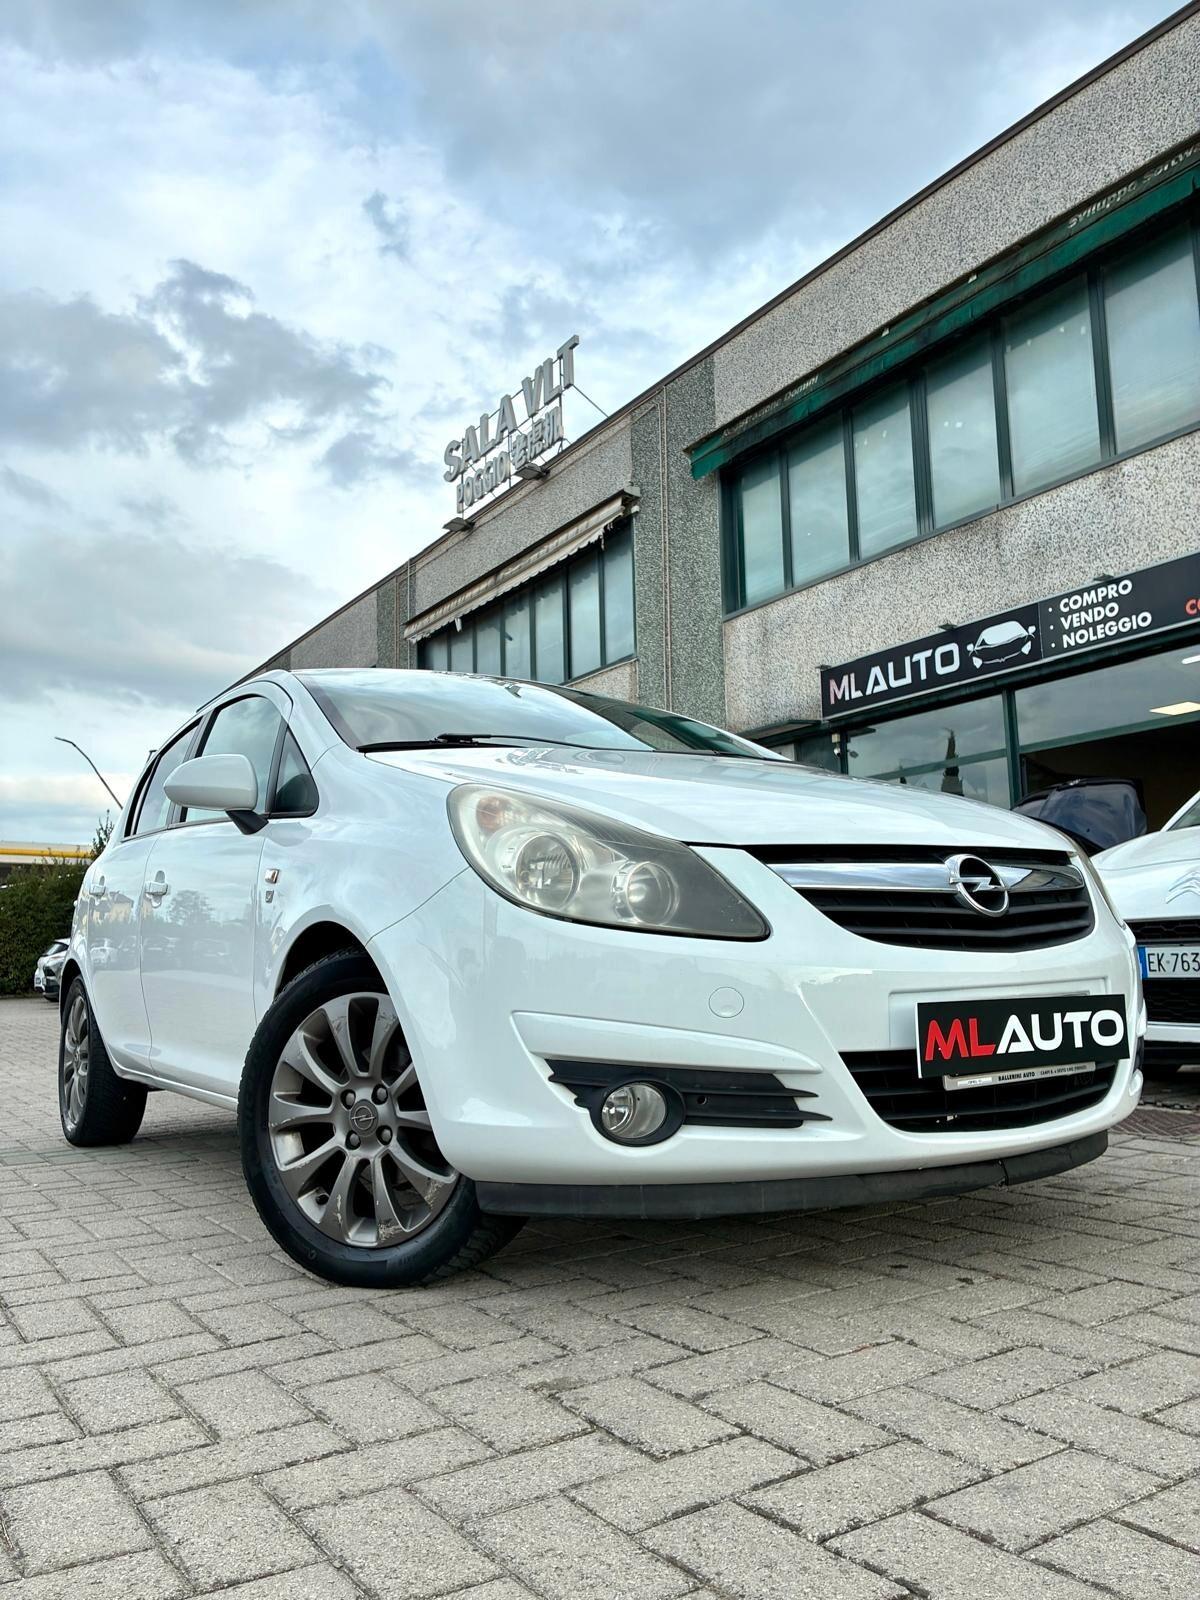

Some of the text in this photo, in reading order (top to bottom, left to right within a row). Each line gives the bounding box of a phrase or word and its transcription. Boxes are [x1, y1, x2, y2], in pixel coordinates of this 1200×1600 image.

[443, 334, 580, 483] SALA VLT
[1059, 579, 1133, 612] COMPRO
[1059, 601, 1120, 630] VENDO
[1062, 611, 1153, 649] NOLEGGIO
